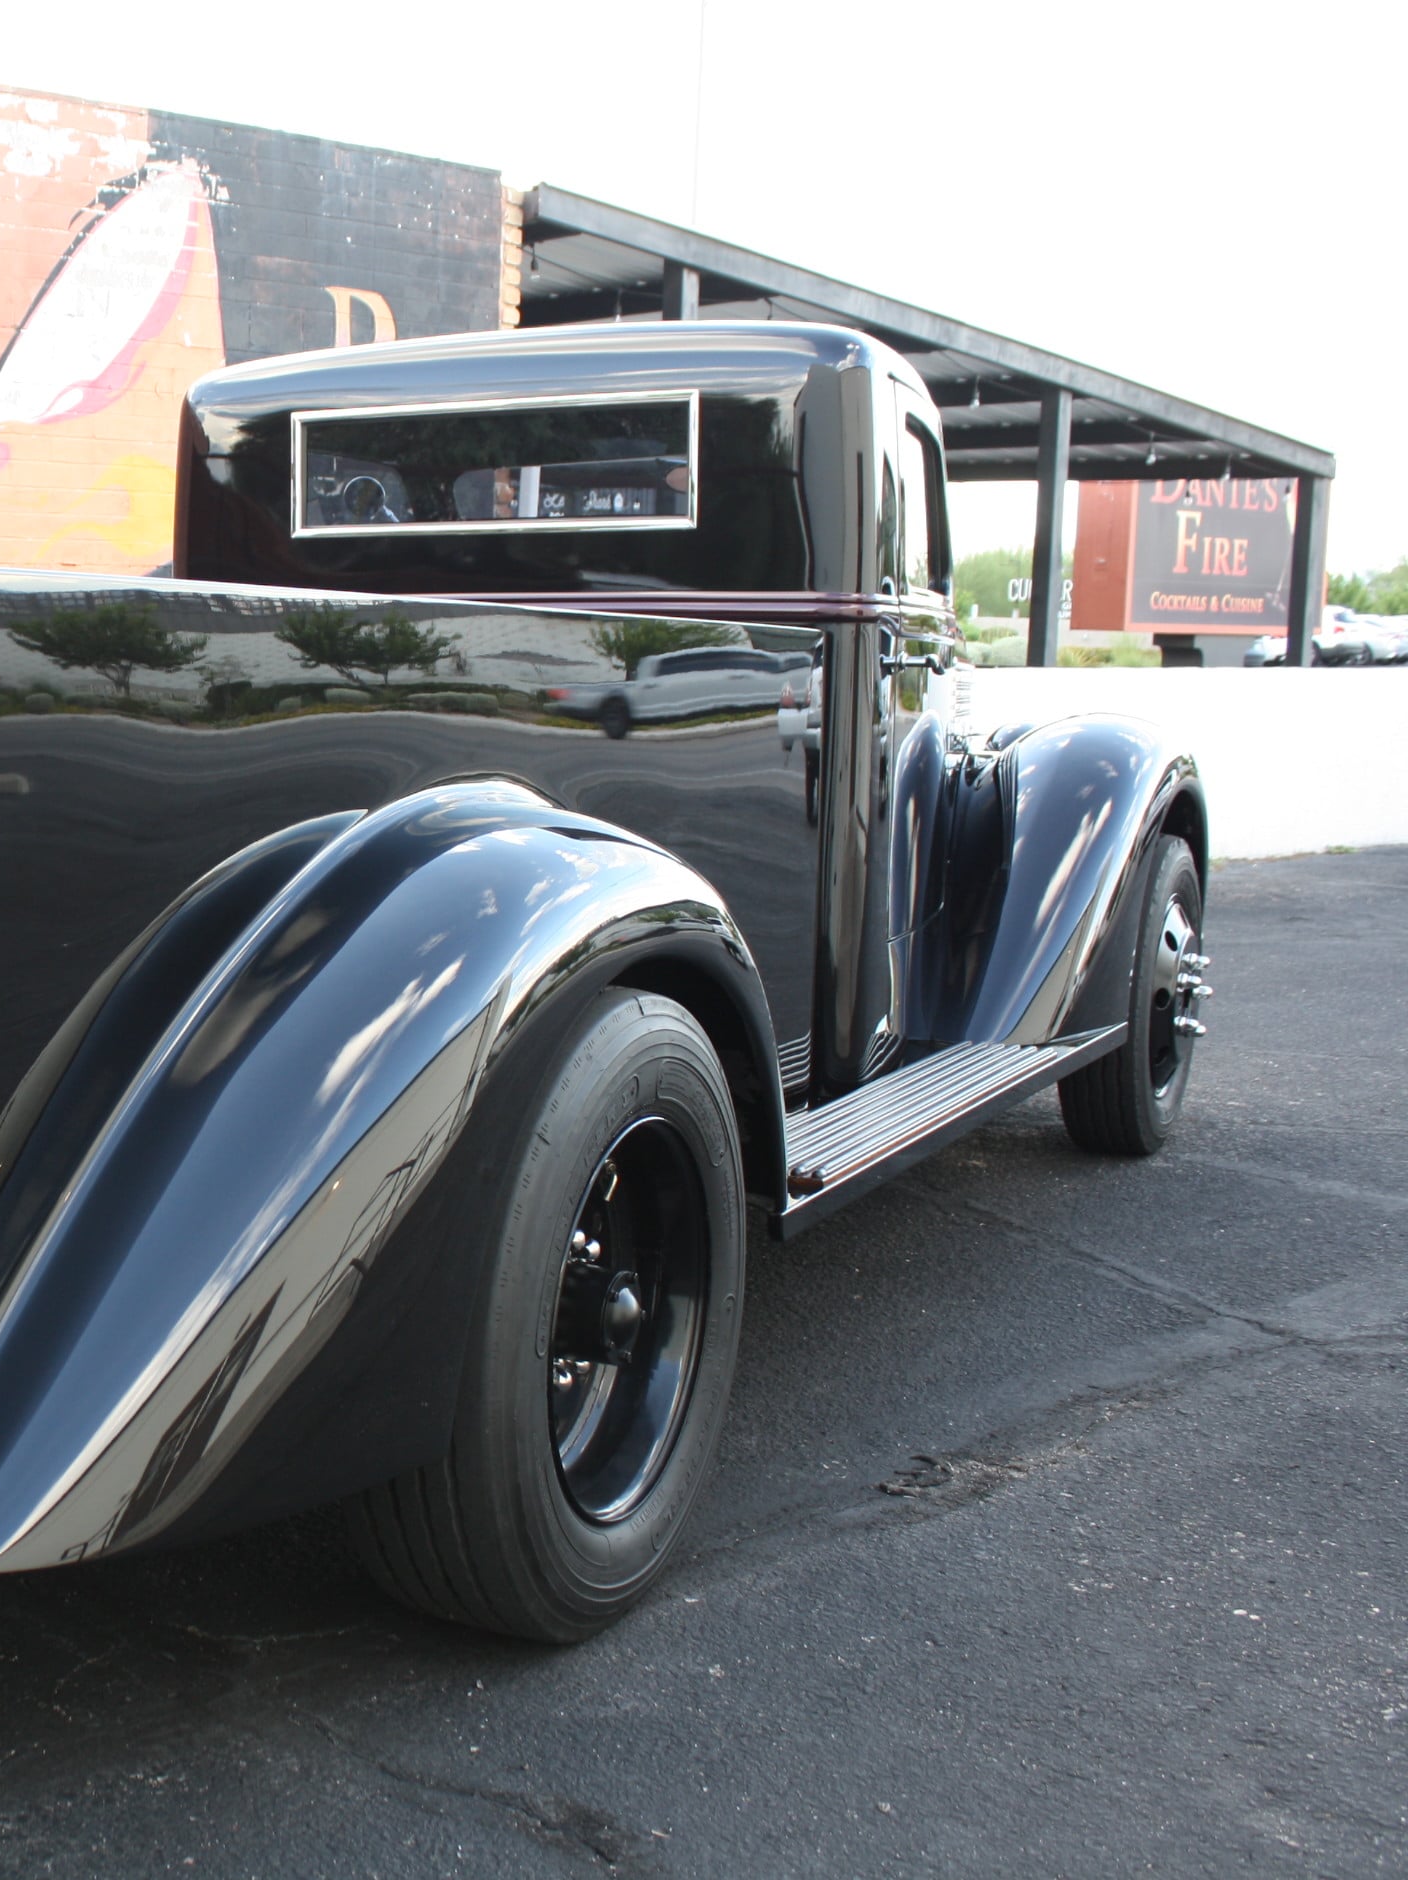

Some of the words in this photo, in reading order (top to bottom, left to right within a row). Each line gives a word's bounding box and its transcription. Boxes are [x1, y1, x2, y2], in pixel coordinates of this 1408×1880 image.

[1172, 509, 1249, 577] FIRE
[1150, 591, 1208, 612] COCKTAILS
[1221, 594, 1265, 613] CUISINE
